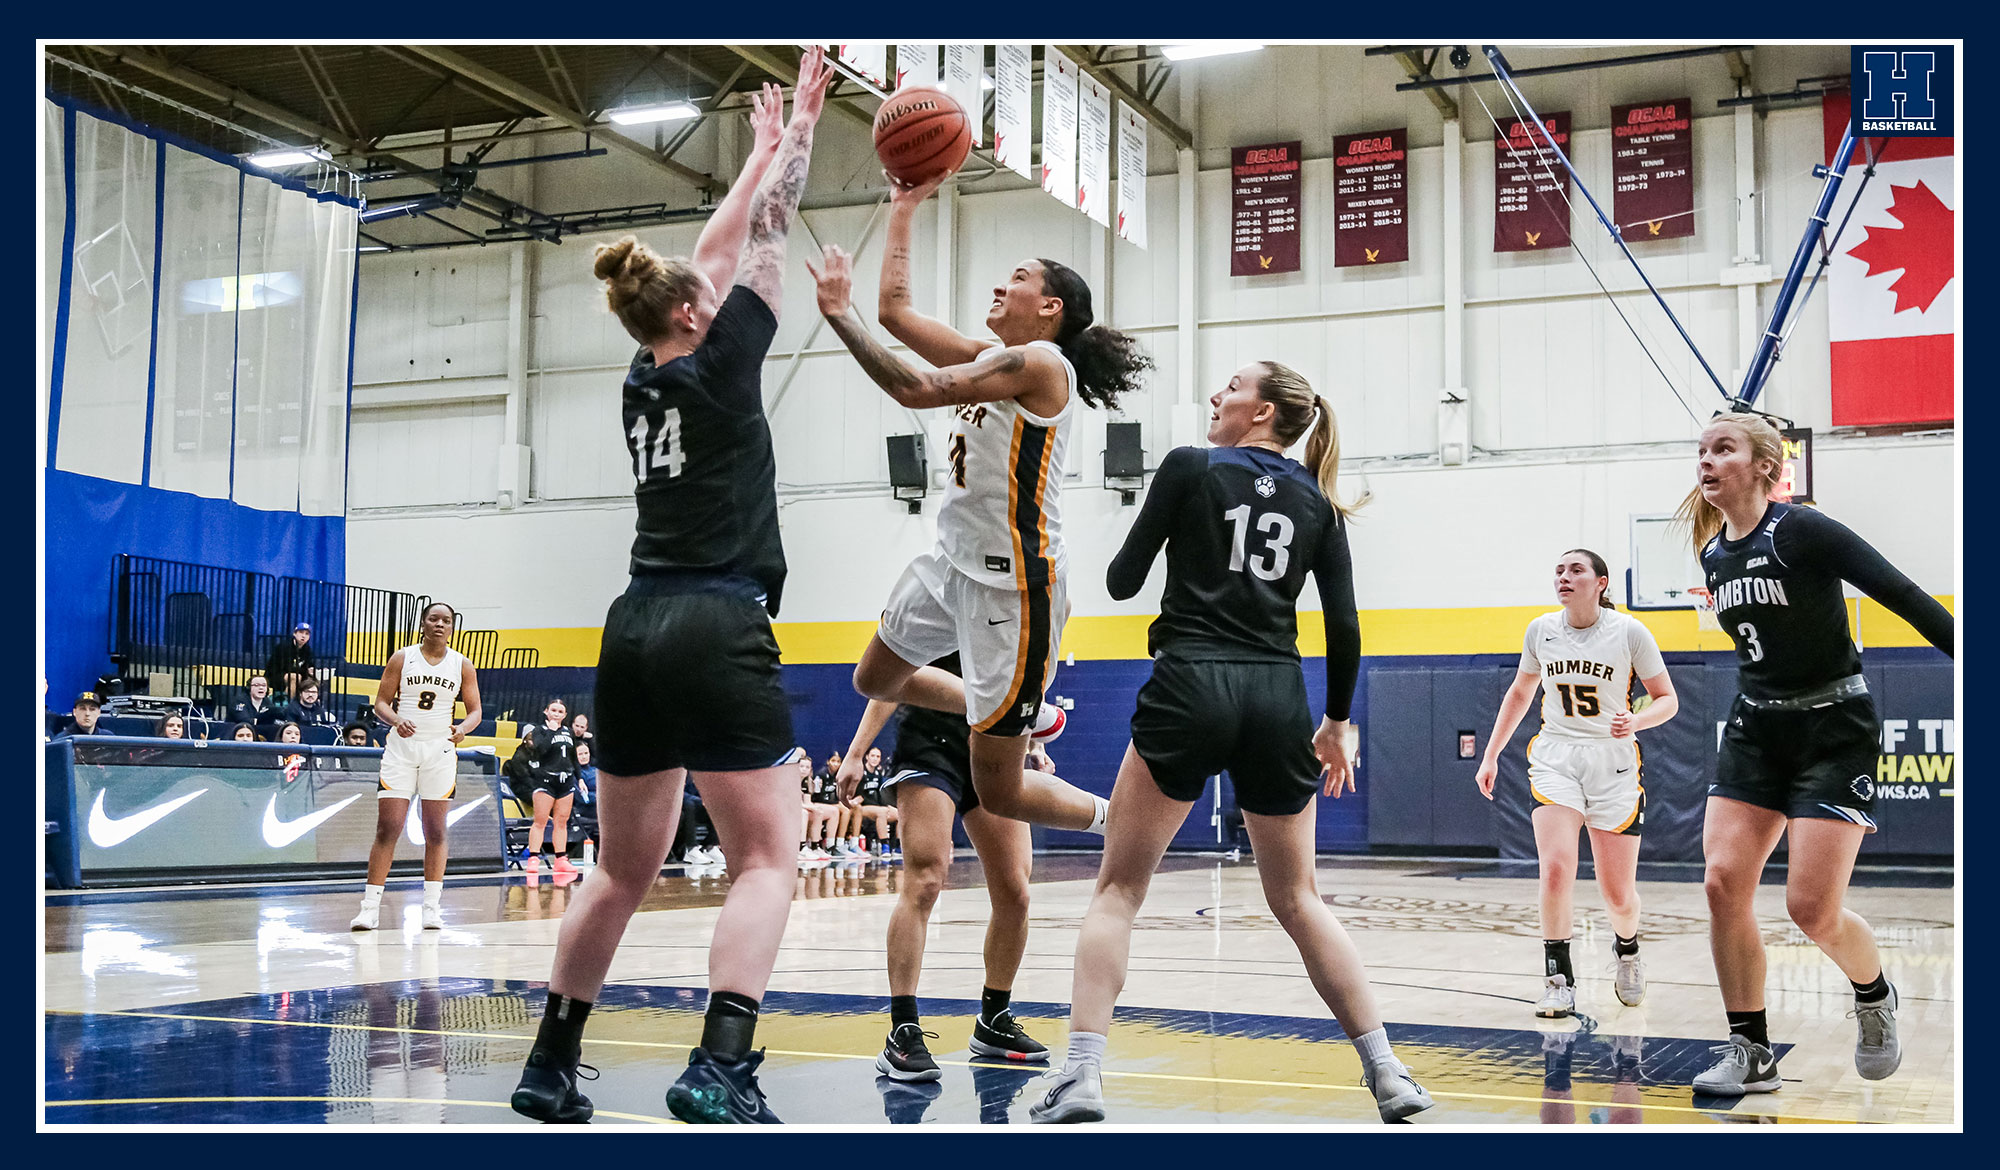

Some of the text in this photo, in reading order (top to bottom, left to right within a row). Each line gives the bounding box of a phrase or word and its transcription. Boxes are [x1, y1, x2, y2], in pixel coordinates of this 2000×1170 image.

[878, 99, 939, 133] Wilson
[1628, 105, 1676, 124] OCAA
[1615, 119, 1689, 136] CHAMPIONS
[1348, 136, 1392, 155] OCAA
[1630, 134, 1676, 144] TABLE TENNIS
[1245, 147, 1287, 164] OCAA
[1336, 150, 1404, 167] CHAMPIONS
[1536, 158, 1562, 166] 1992-9
[1641, 159, 1665, 167] TENNIS
[1234, 161, 1299, 175] CHAMPIONS
[1345, 163, 1395, 174] WOMEN'S RUGBY
[1339, 173, 1402, 186] 2010-11 2012-13
[1339, 182, 1402, 194] 2011-12 2014-15
[1618, 182, 1648, 192] 1972-73
[1368, 197, 1394, 206] CURLING
[1268, 224, 1294, 233] 2003-04
[1339, 221, 1367, 230] 2013-14
[630, 407, 687, 484] 14
[1224, 504, 1295, 581] 13
[1745, 555, 1769, 570] OCAA
[1737, 622, 1764, 662] 3
[1546, 659, 1615, 681] HUMBER
[406, 675, 456, 692] HUMBER
[418, 690, 437, 711] 8
[1556, 683, 1600, 717] 15
[1879, 719, 1908, 753] F
[560, 744, 567, 758] 1
